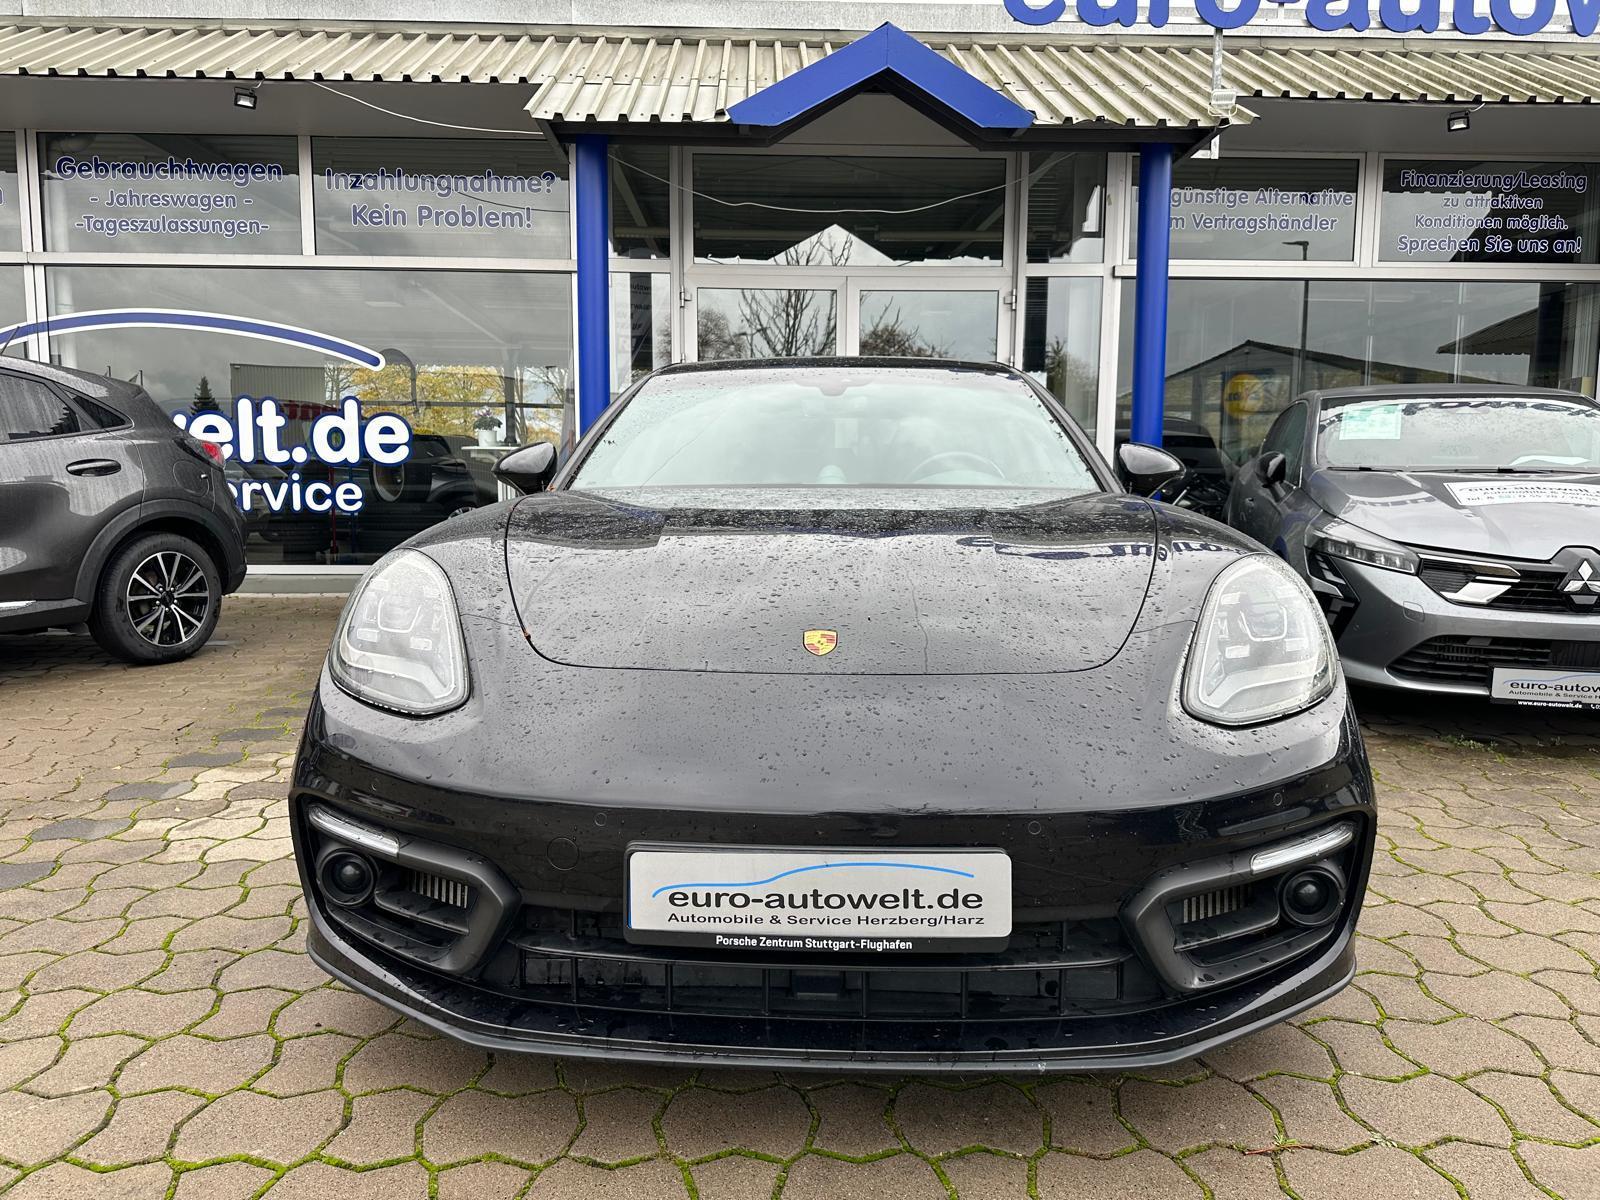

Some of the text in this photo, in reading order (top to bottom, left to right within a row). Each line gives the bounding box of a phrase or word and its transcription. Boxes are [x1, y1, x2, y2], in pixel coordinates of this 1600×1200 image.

[55, 156, 283, 187] Gebrauchtwagen
[325, 168, 556, 197] Inzahlungnahme?
[1400, 169, 1588, 193] Finanzierung/Leasing
[104, 189, 237, 213] Jahreswagen
[1170, 187, 1353, 208] günstige Alternative
[1442, 194, 1543, 209] zu attraktiven
[75, 214, 270, 238] -Tageszulassungen-
[351, 203, 533, 229] Kein Problem!
[1170, 213, 1338, 234] m Vertragshändler
[1414, 214, 1568, 233] Konditionen möglich.
[1397, 235, 1582, 254] Sprechen Sie uns an!
[172, 395, 412, 466] elt.de
[228, 472, 363, 512] rvice
[668, 888, 983, 910] euro-autowelt.de
[668, 913, 984, 927] Automobile & Service Herzberg/Harz
[716, 935, 913, 951] Porsche Zentrum Stuttgart-Flughafen
